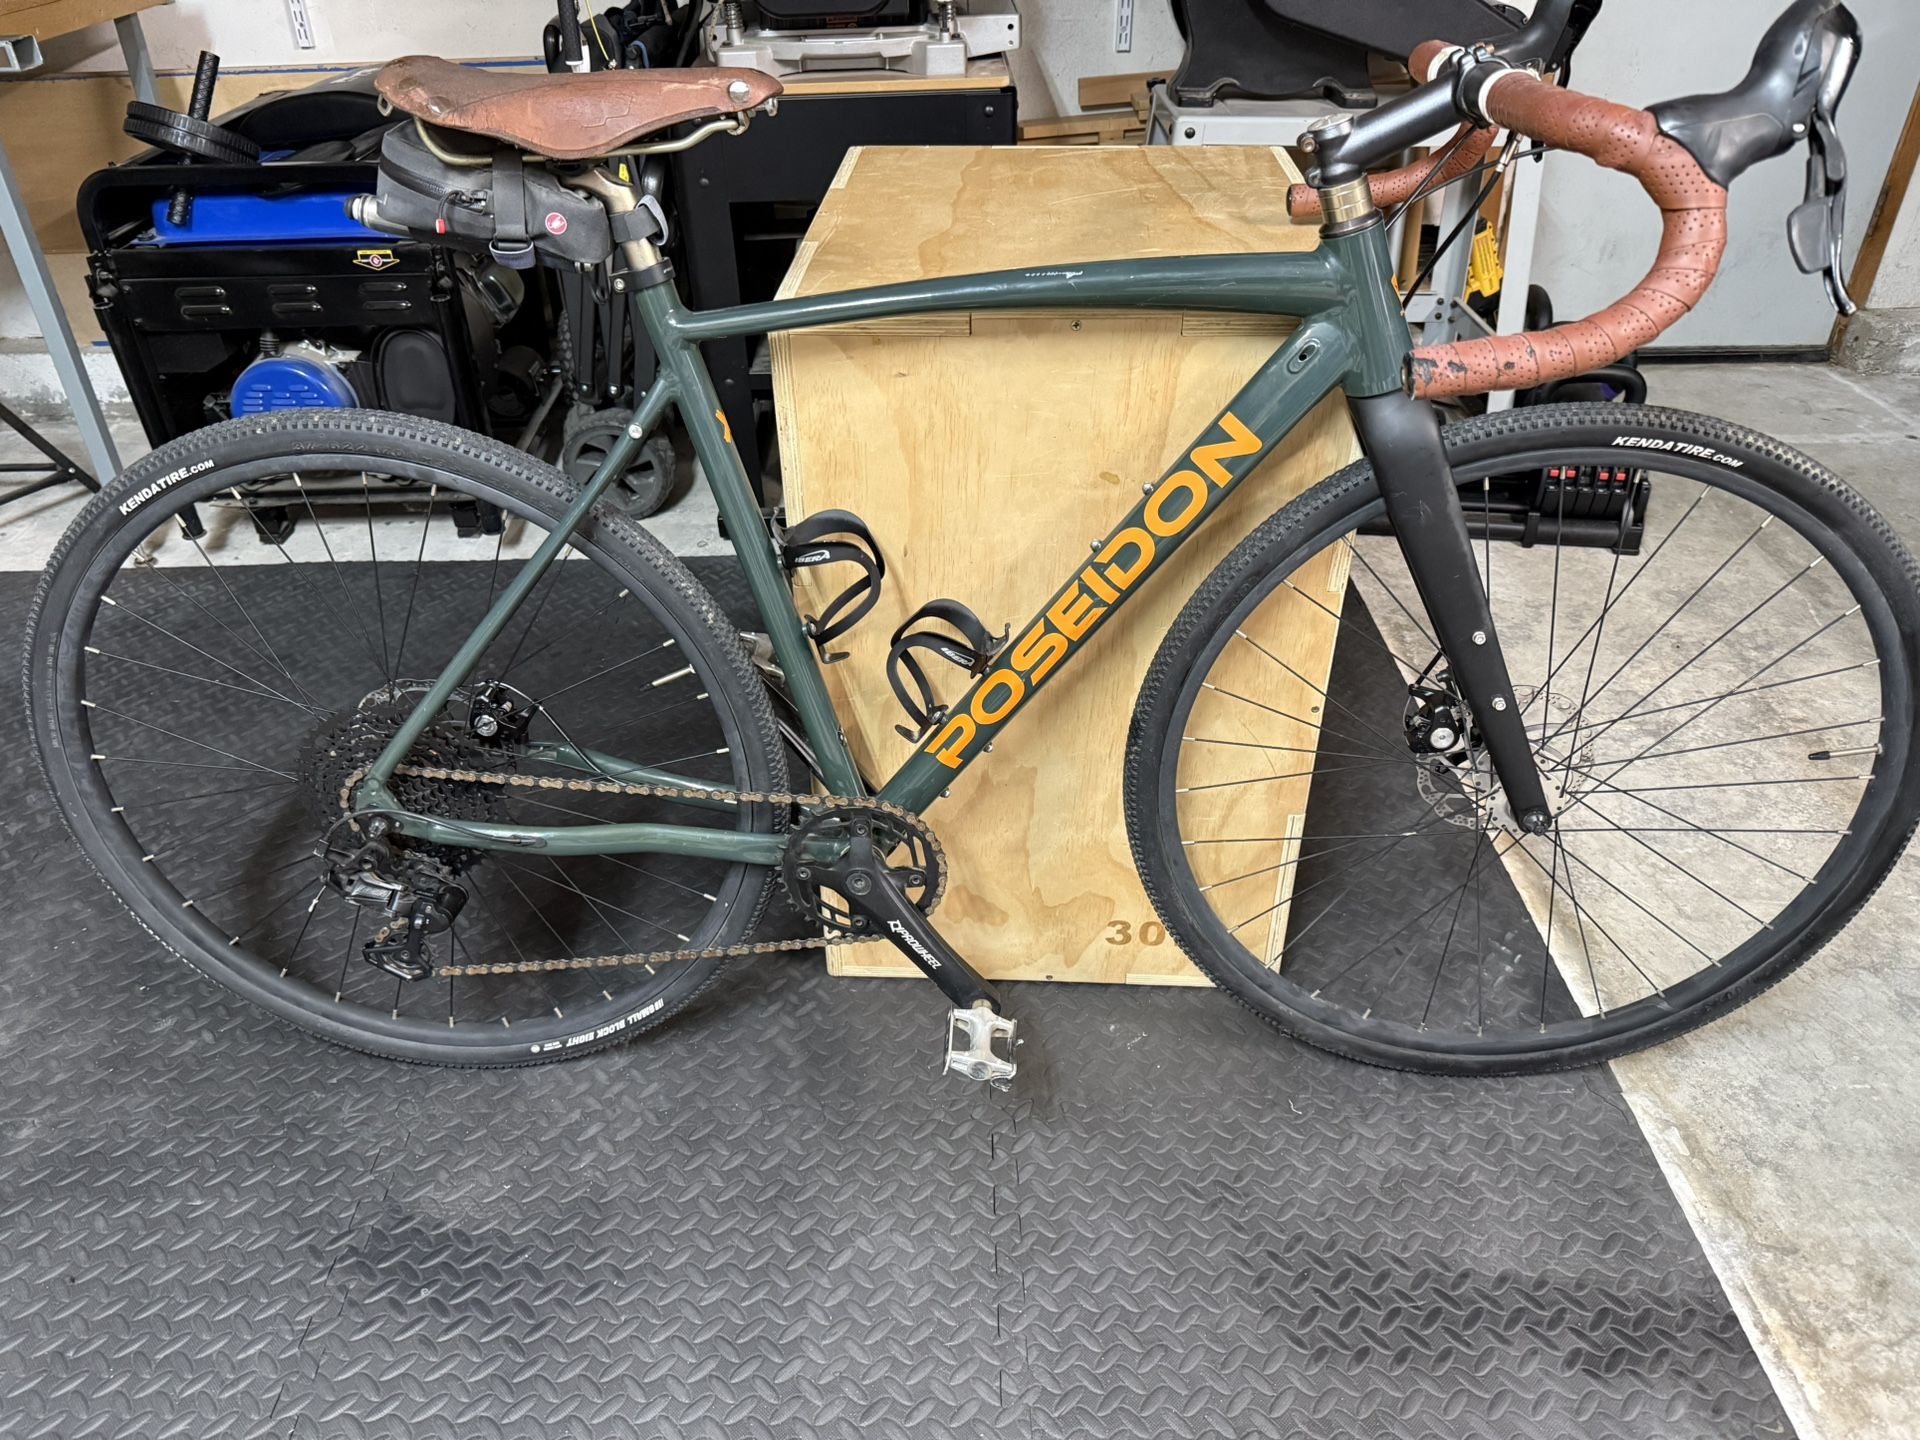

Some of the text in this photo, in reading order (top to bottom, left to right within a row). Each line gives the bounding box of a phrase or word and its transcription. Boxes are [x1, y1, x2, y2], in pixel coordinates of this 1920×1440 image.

[1611, 436, 1743, 468] KENDATIRE.COM
[119, 459, 215, 516] KENDATIRE.COM
[924, 411, 1263, 769] POSEIDON
[1105, 920, 1166, 946] 30
[896, 927, 942, 970] PROWHEEL
[596, 1018, 626, 1039] BLOCK
[627, 1003, 655, 1025] SMALL
[566, 1031, 595, 1048] EIGHT
